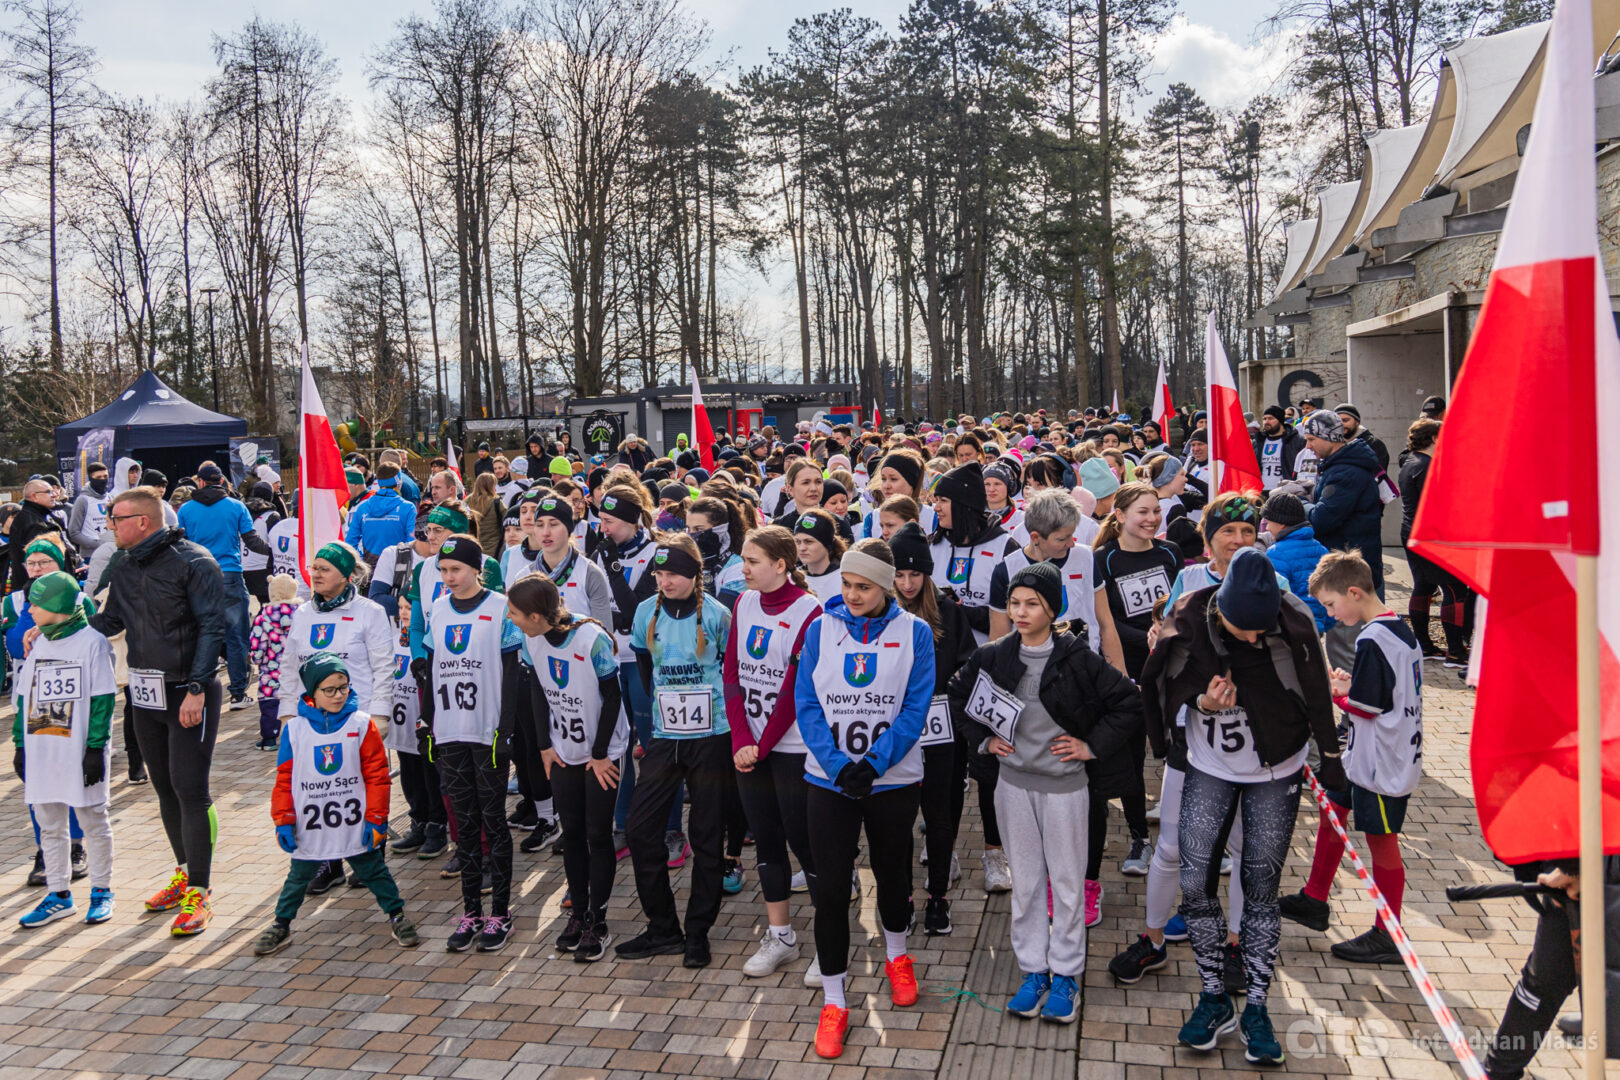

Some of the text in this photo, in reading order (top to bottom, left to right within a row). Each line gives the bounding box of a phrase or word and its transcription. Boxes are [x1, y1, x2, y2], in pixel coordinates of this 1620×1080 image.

[960, 588, 985, 600] Sącz
[1131, 585, 1165, 607] 316
[440, 658, 482, 670] owy Sącz
[740, 662, 758, 674] owy
[760, 664, 784, 679] Sącz
[43, 678, 76, 696] 335
[134, 686, 157, 702] 351
[438, 682, 478, 710] 163
[826, 692, 894, 706] Nowy Sącz
[667, 706, 704, 724] 314
[974, 696, 1006, 729] 347
[1202, 716, 1256, 754] 15
[301, 776, 358, 791] Nowy Sącz
[303, 798, 362, 830] 263
